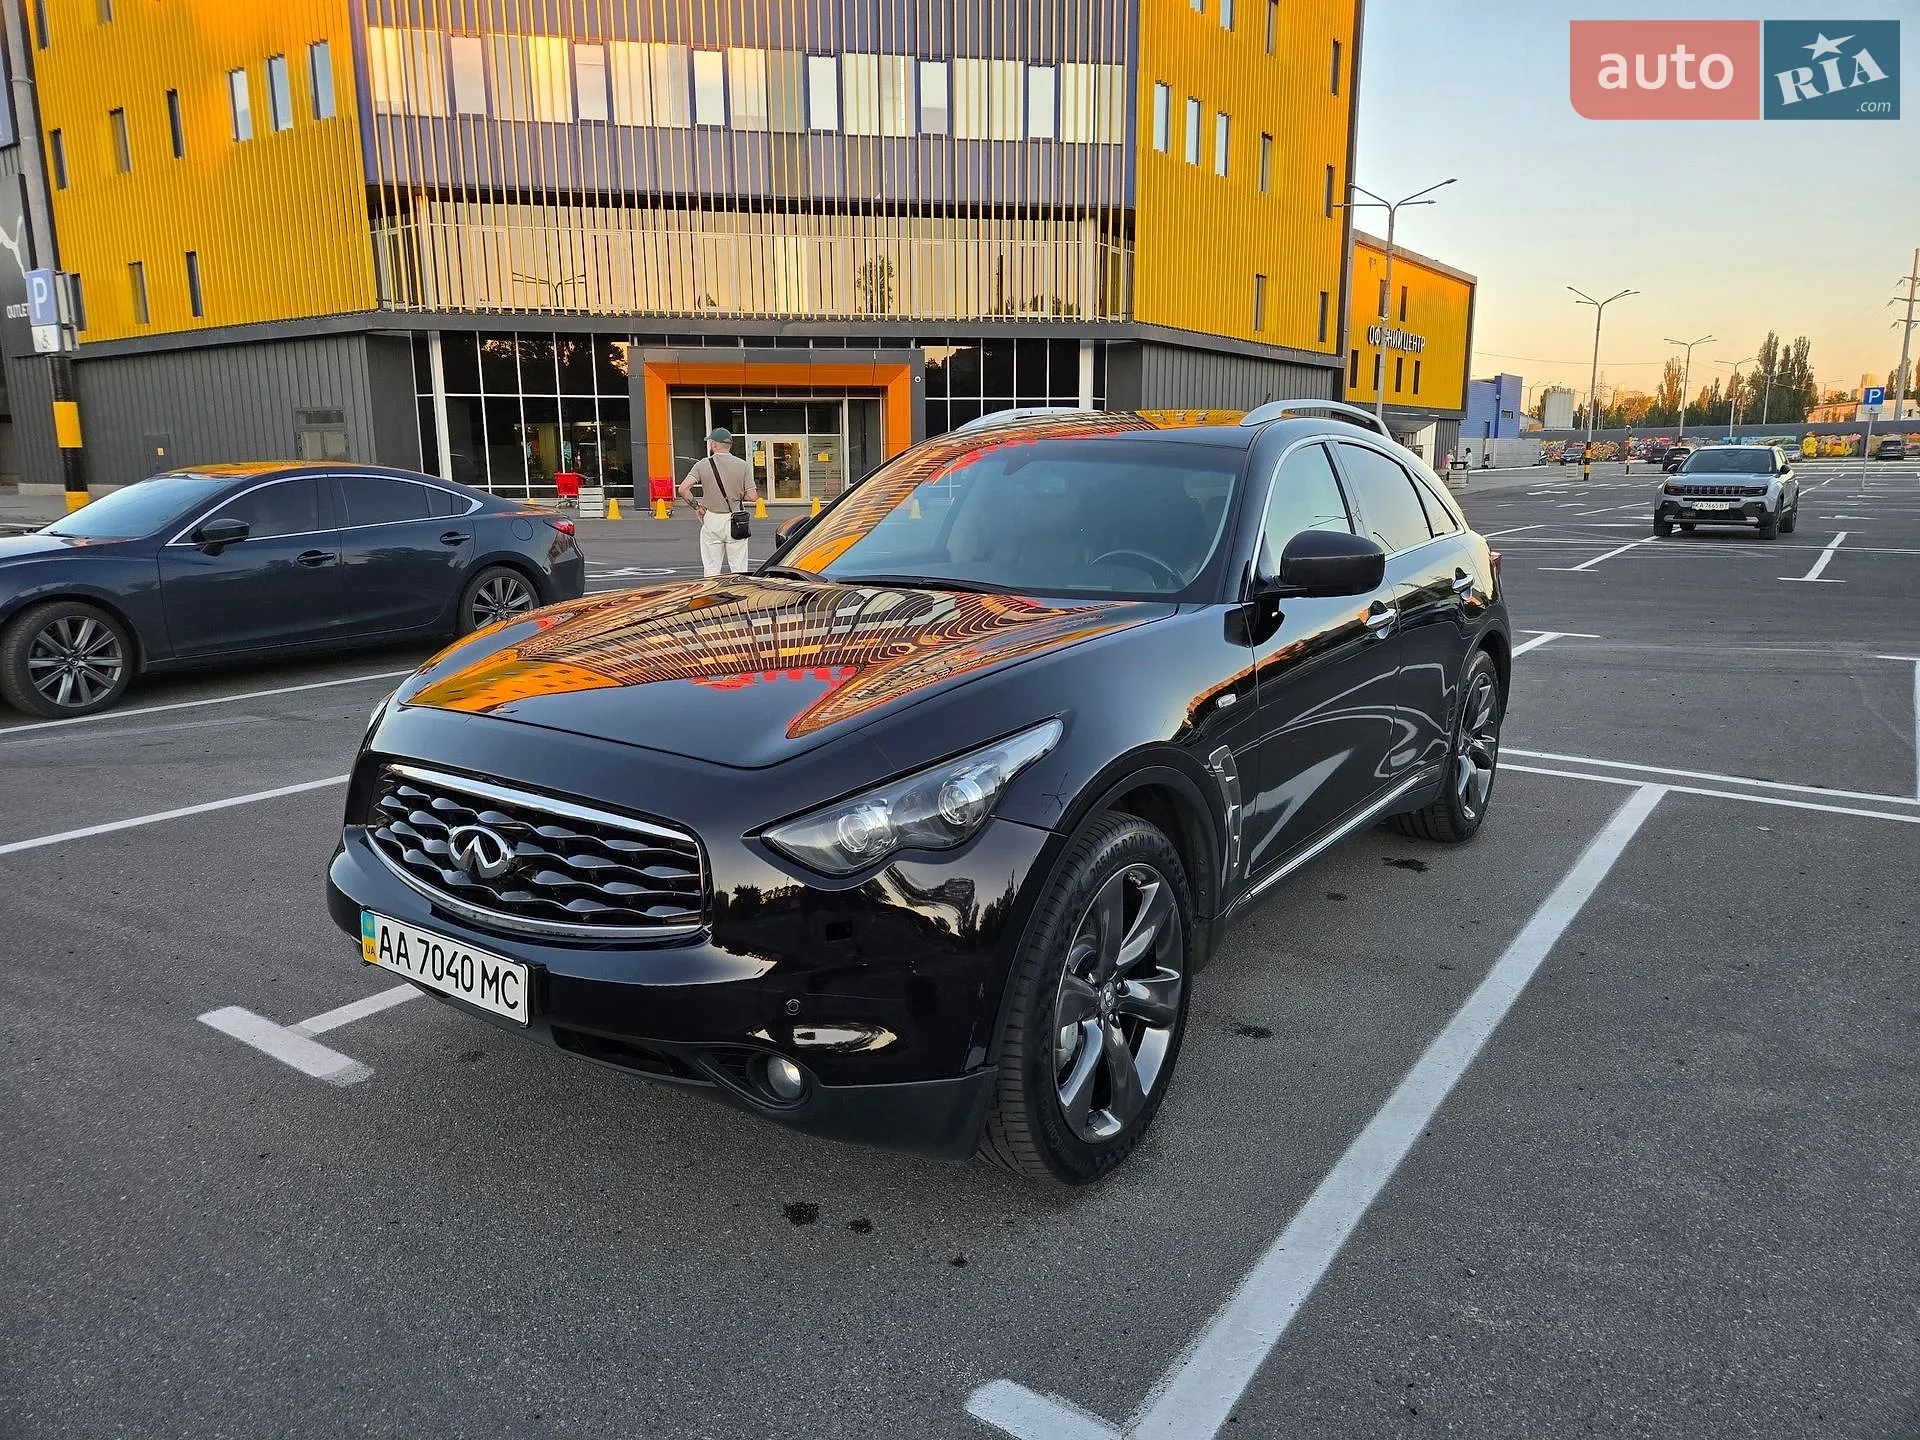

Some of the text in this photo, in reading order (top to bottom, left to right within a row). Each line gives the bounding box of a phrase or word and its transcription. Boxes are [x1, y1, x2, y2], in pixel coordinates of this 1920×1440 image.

[32, 276, 48, 320] P
[1868, 388, 1882, 403] P
[365, 944, 376, 956] UA
[379, 925, 519, 1010] AA 7040 MC
